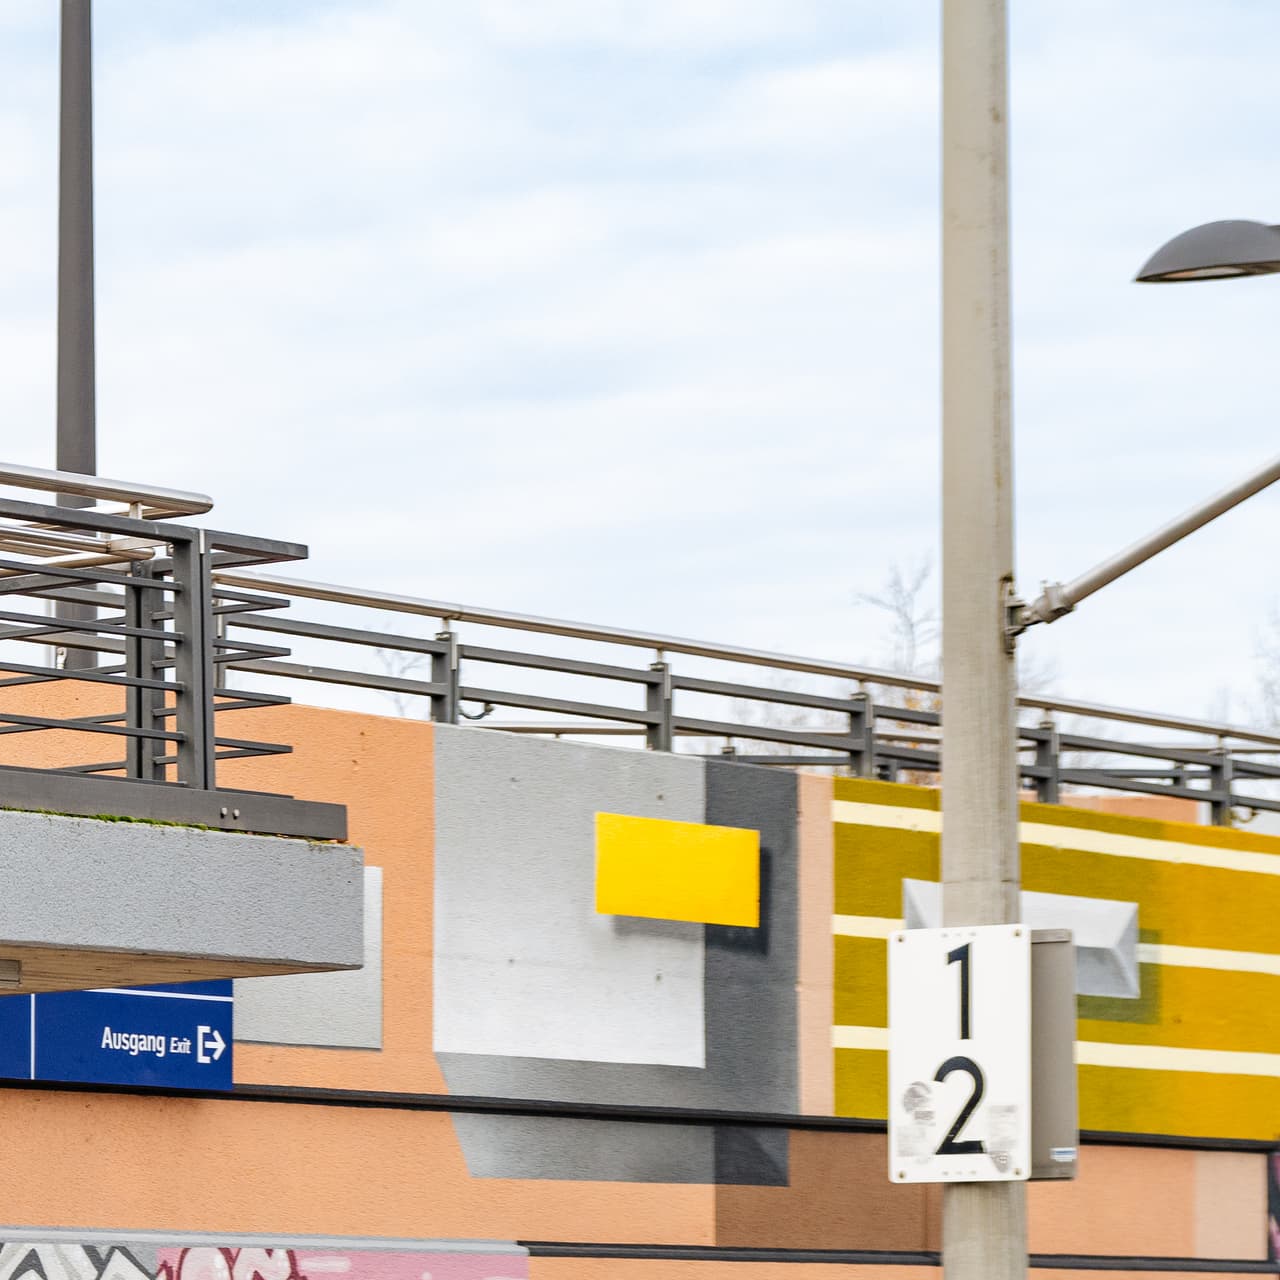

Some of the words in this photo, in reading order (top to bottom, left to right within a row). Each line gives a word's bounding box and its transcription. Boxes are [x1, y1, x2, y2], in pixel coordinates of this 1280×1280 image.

[946, 942, 972, 1040] 1
[101, 1026, 166, 1058] Ausgang
[169, 1037, 192, 1055] Exit
[933, 1055, 986, 1155] 2
